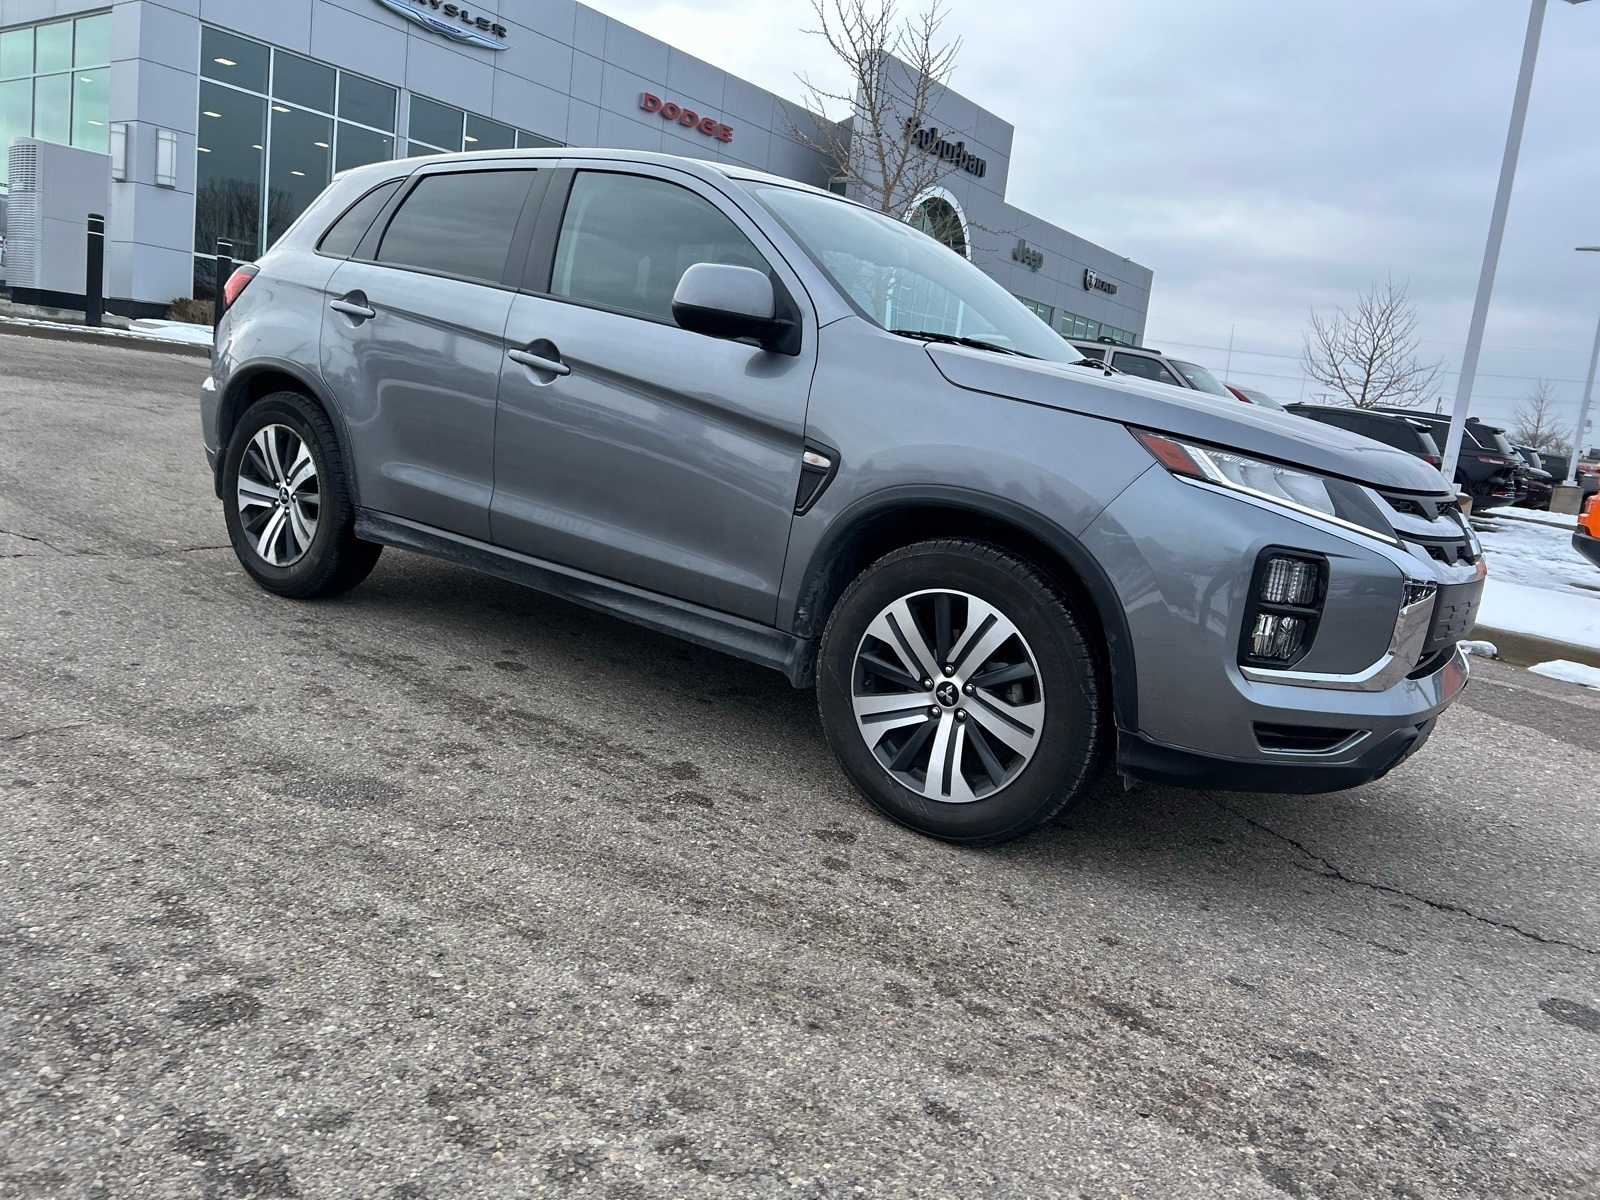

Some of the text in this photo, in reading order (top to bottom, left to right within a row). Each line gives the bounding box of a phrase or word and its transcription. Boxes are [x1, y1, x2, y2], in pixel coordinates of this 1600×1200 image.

[411, 0, 507, 38] YSLER
[640, 92, 734, 143] DODGE
[1012, 239, 1044, 272] Jeep
